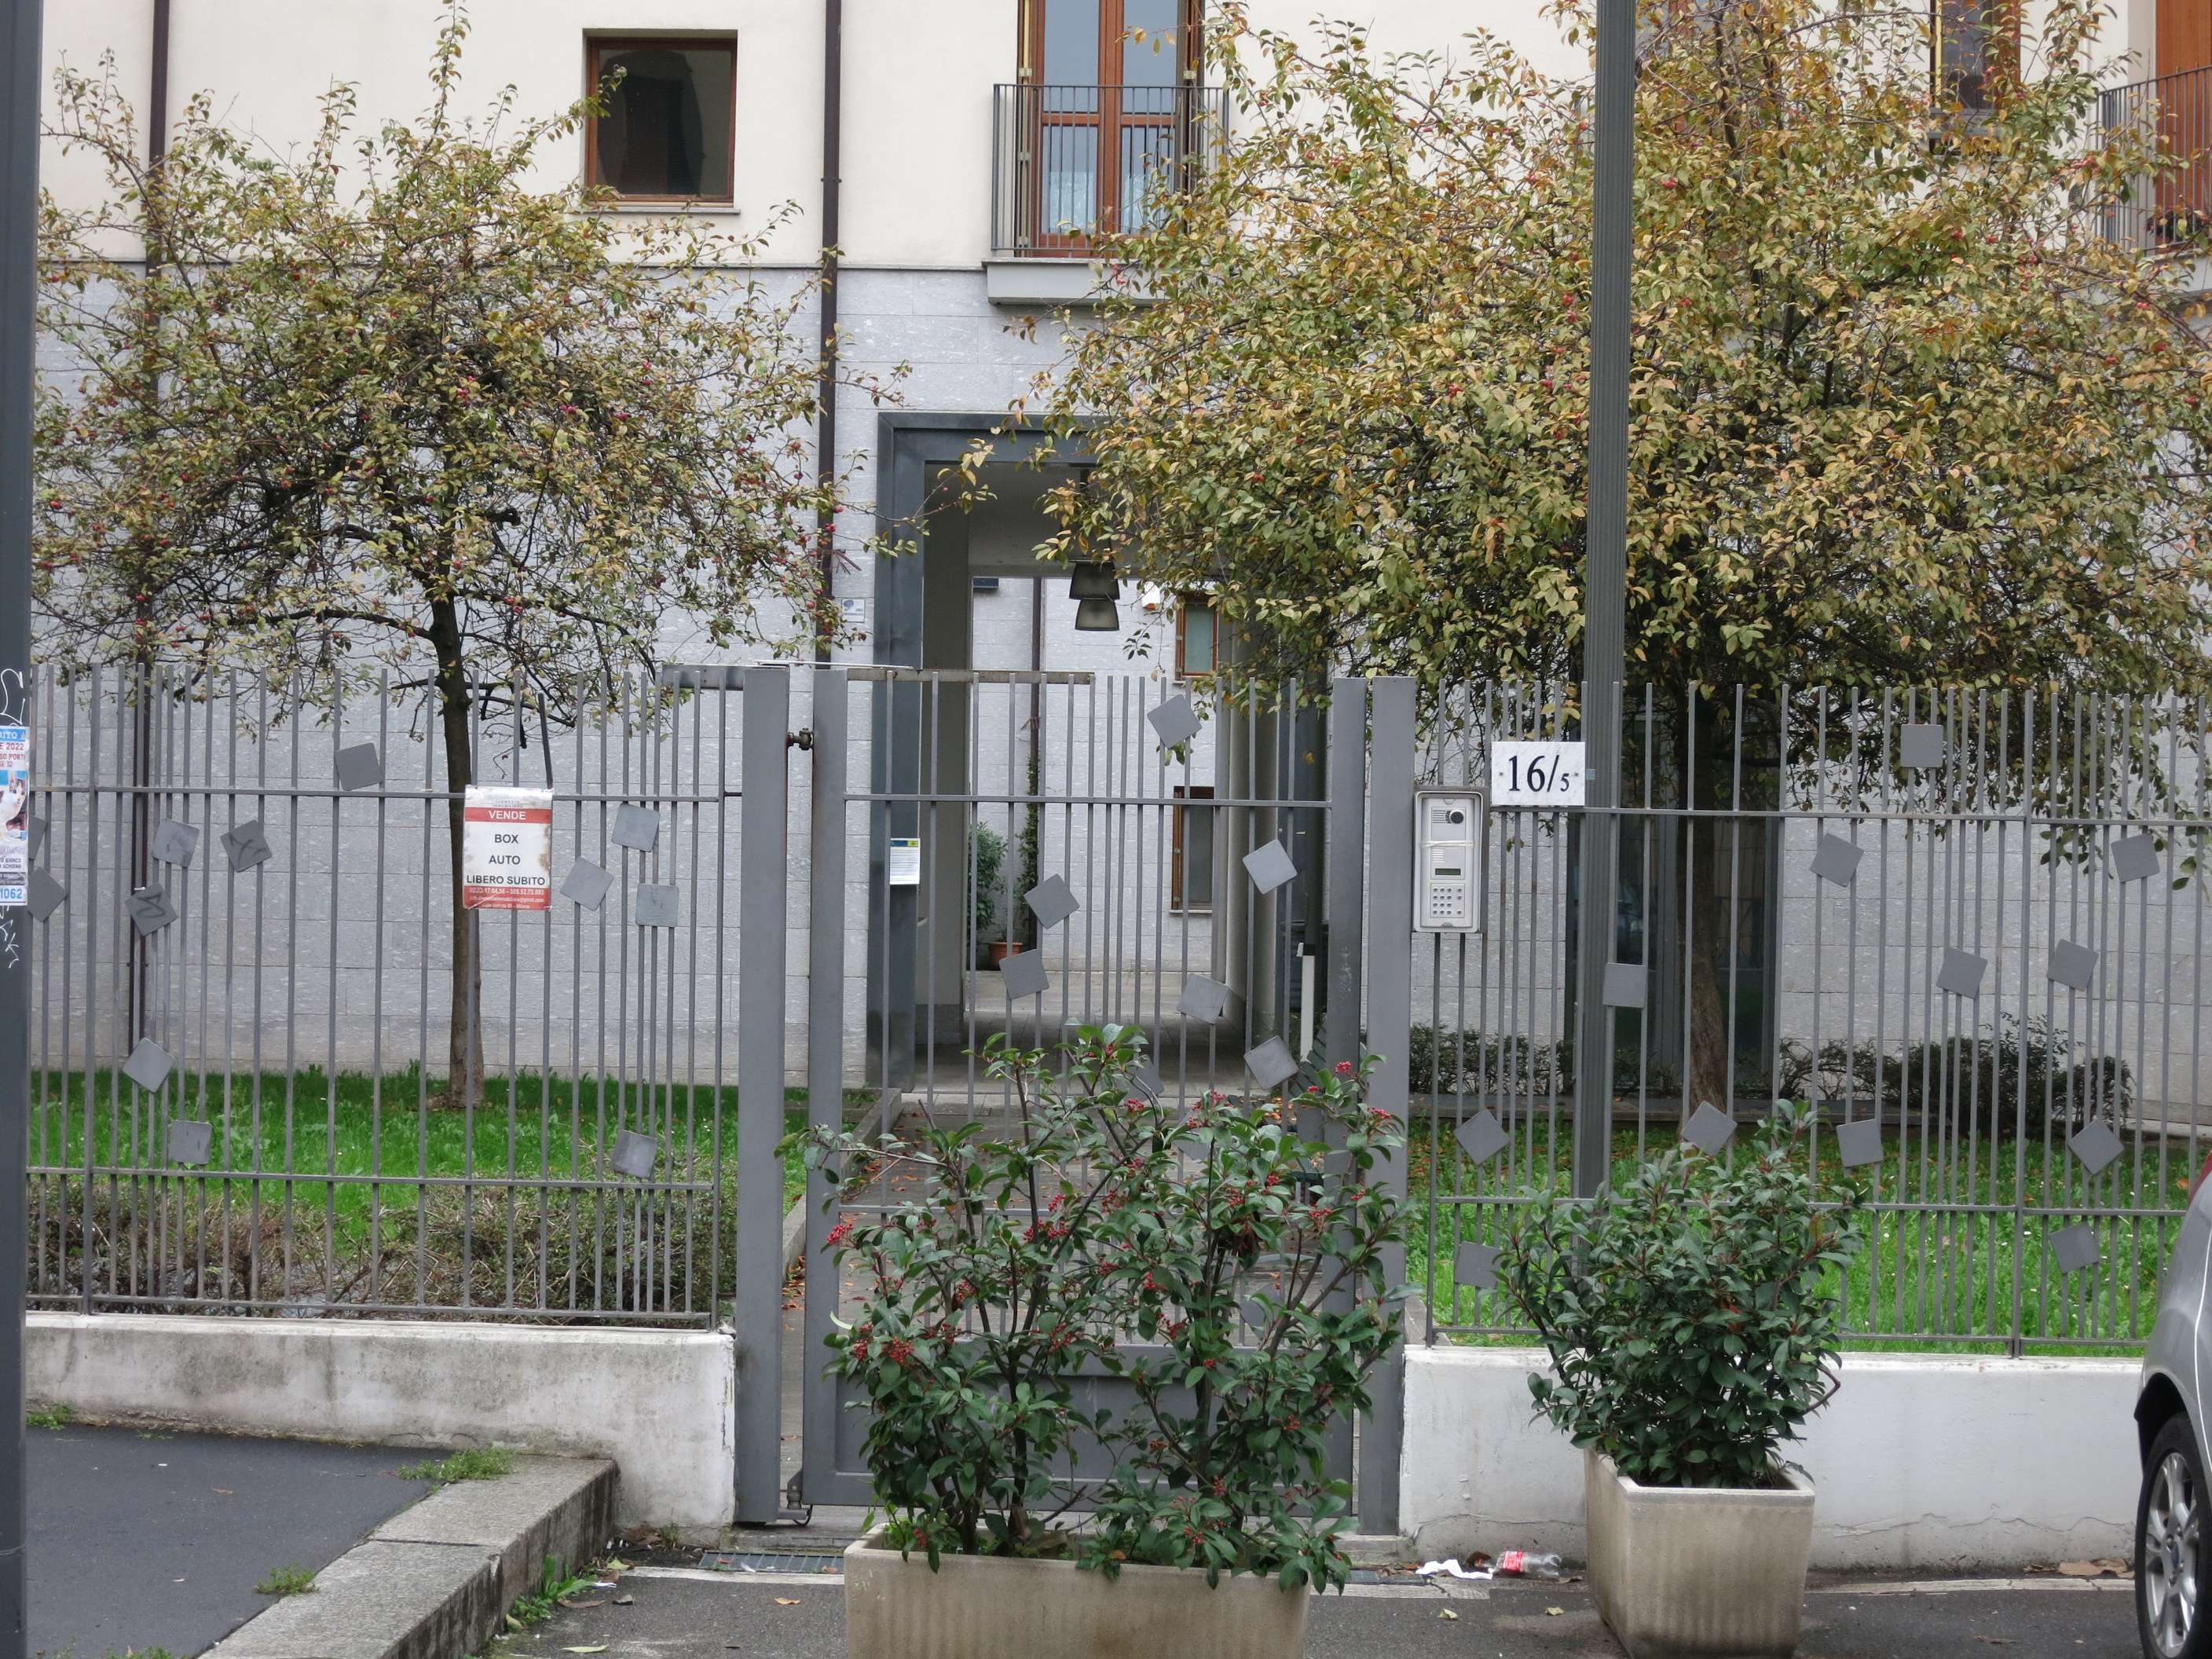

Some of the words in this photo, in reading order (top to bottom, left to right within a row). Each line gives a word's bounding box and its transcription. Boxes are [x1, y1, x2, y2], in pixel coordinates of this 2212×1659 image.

[1508, 754, 1569, 792] 16/5
[489, 810, 526, 820] VENDE
[494, 834, 519, 844] BOX
[489, 855, 521, 865] AUTO
[467, 875, 504, 884] LIBERO
[507, 876, 545, 886] SUBITO
